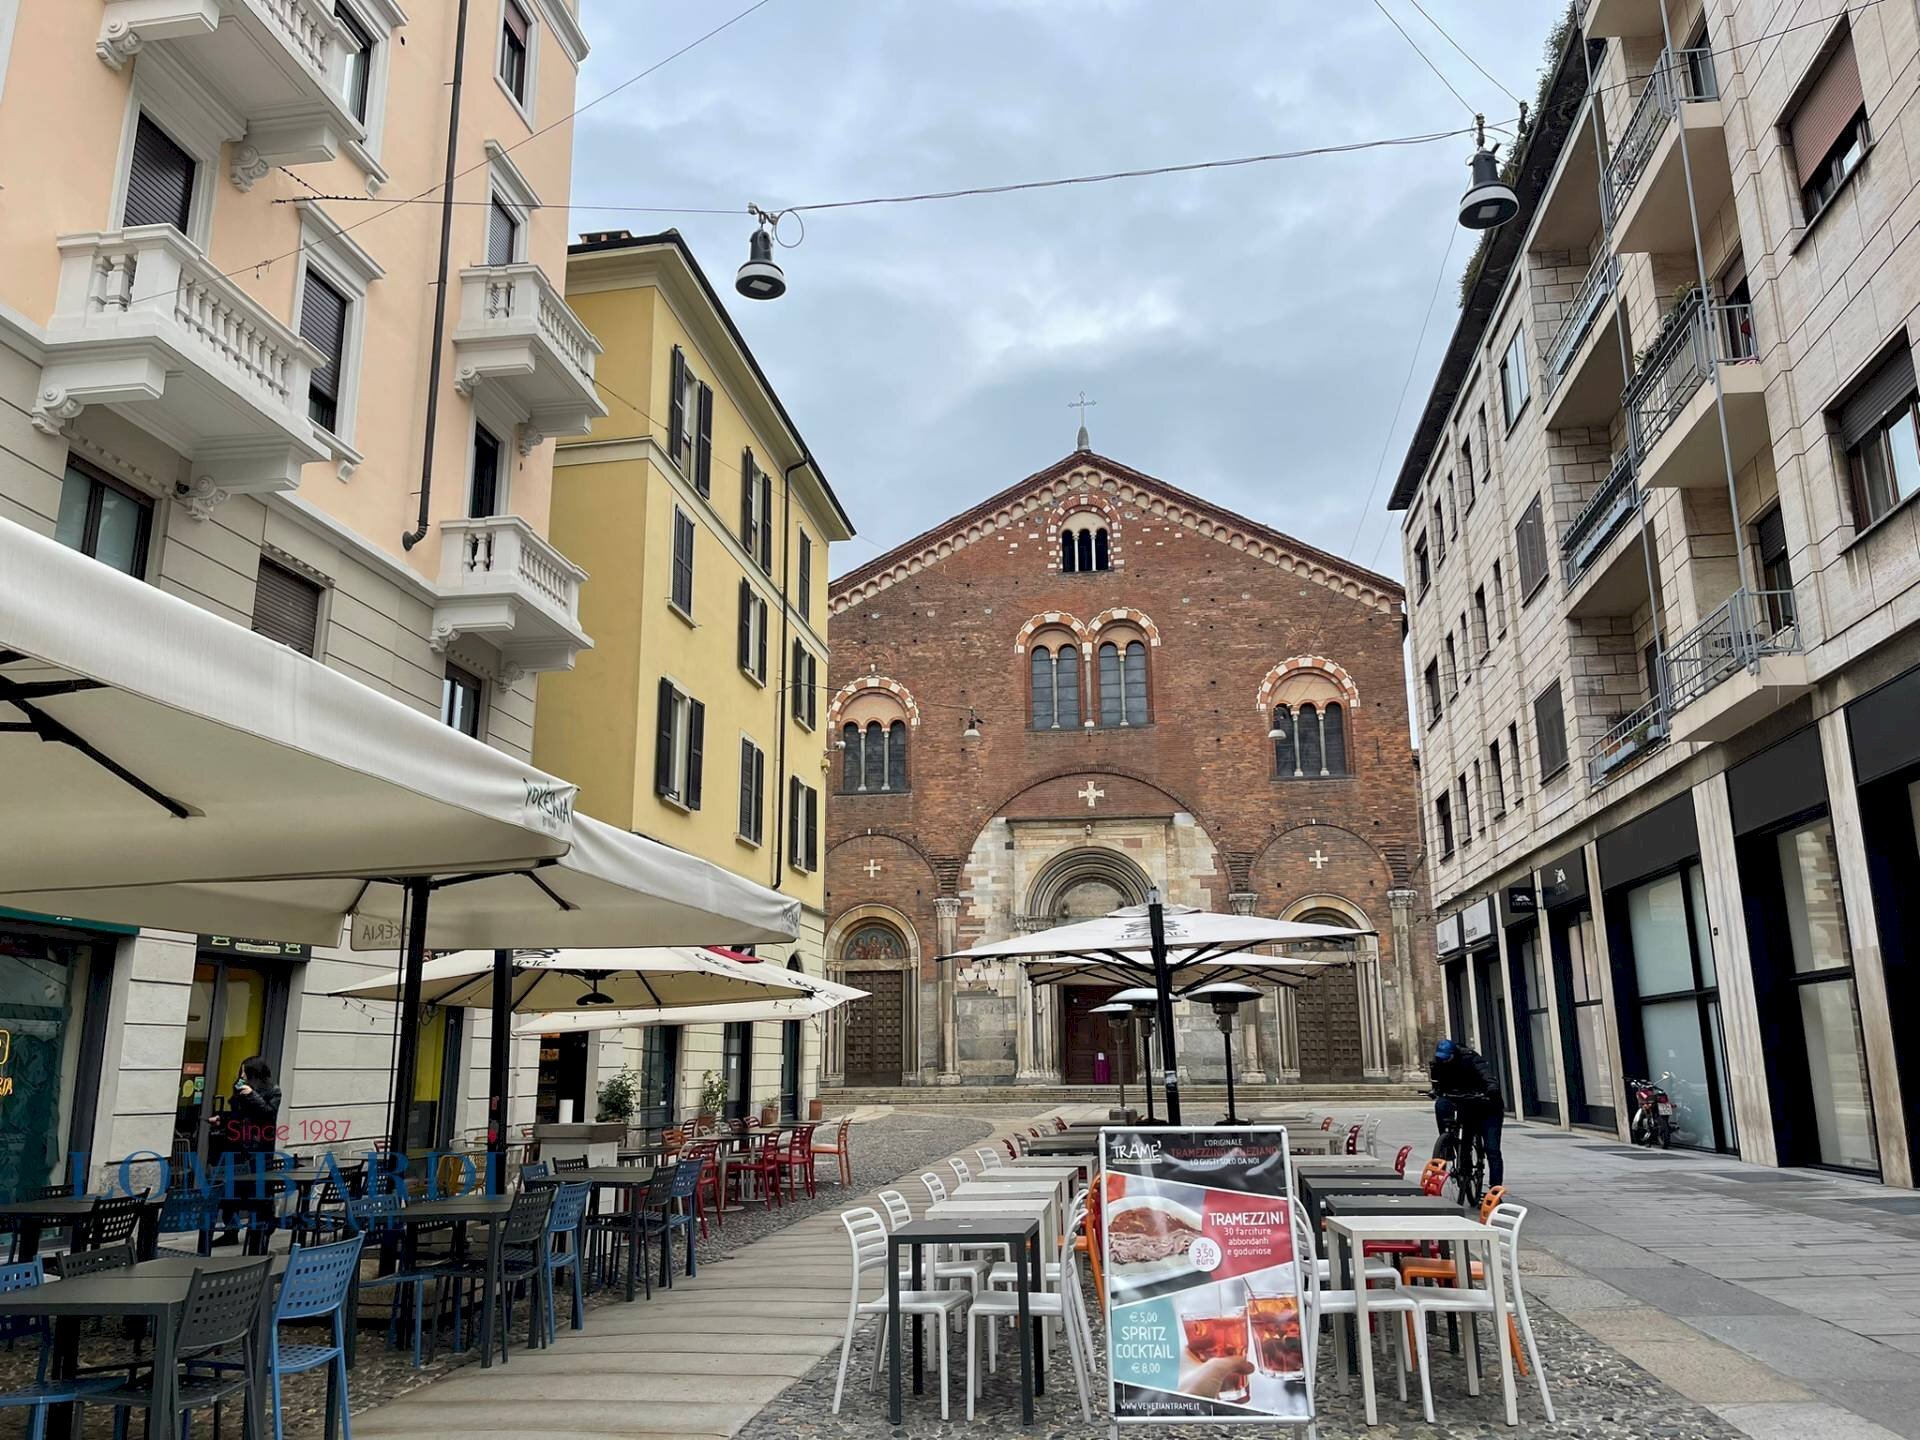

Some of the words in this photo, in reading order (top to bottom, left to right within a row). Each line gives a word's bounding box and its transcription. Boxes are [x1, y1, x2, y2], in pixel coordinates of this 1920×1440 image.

[1204, 1139, 1243, 1147] L'ORIGINALE
[1190, 1158, 1199, 1166] LO
[1248, 1157, 1260, 1165] NOI
[1208, 1211, 1284, 1226] TRAMEZZINI
[1224, 1227, 1233, 1236] 30
[1236, 1227, 1272, 1236] farciture
[1228, 1238, 1269, 1246] abbondanti
[1196, 1248, 1214, 1258] 3,50
[1234, 1248, 1272, 1257] goduriose
[1196, 1258, 1215, 1266] euro
[1121, 1326, 1167, 1341] SPRITZ
[1116, 1344, 1175, 1359] COCKTAIL
